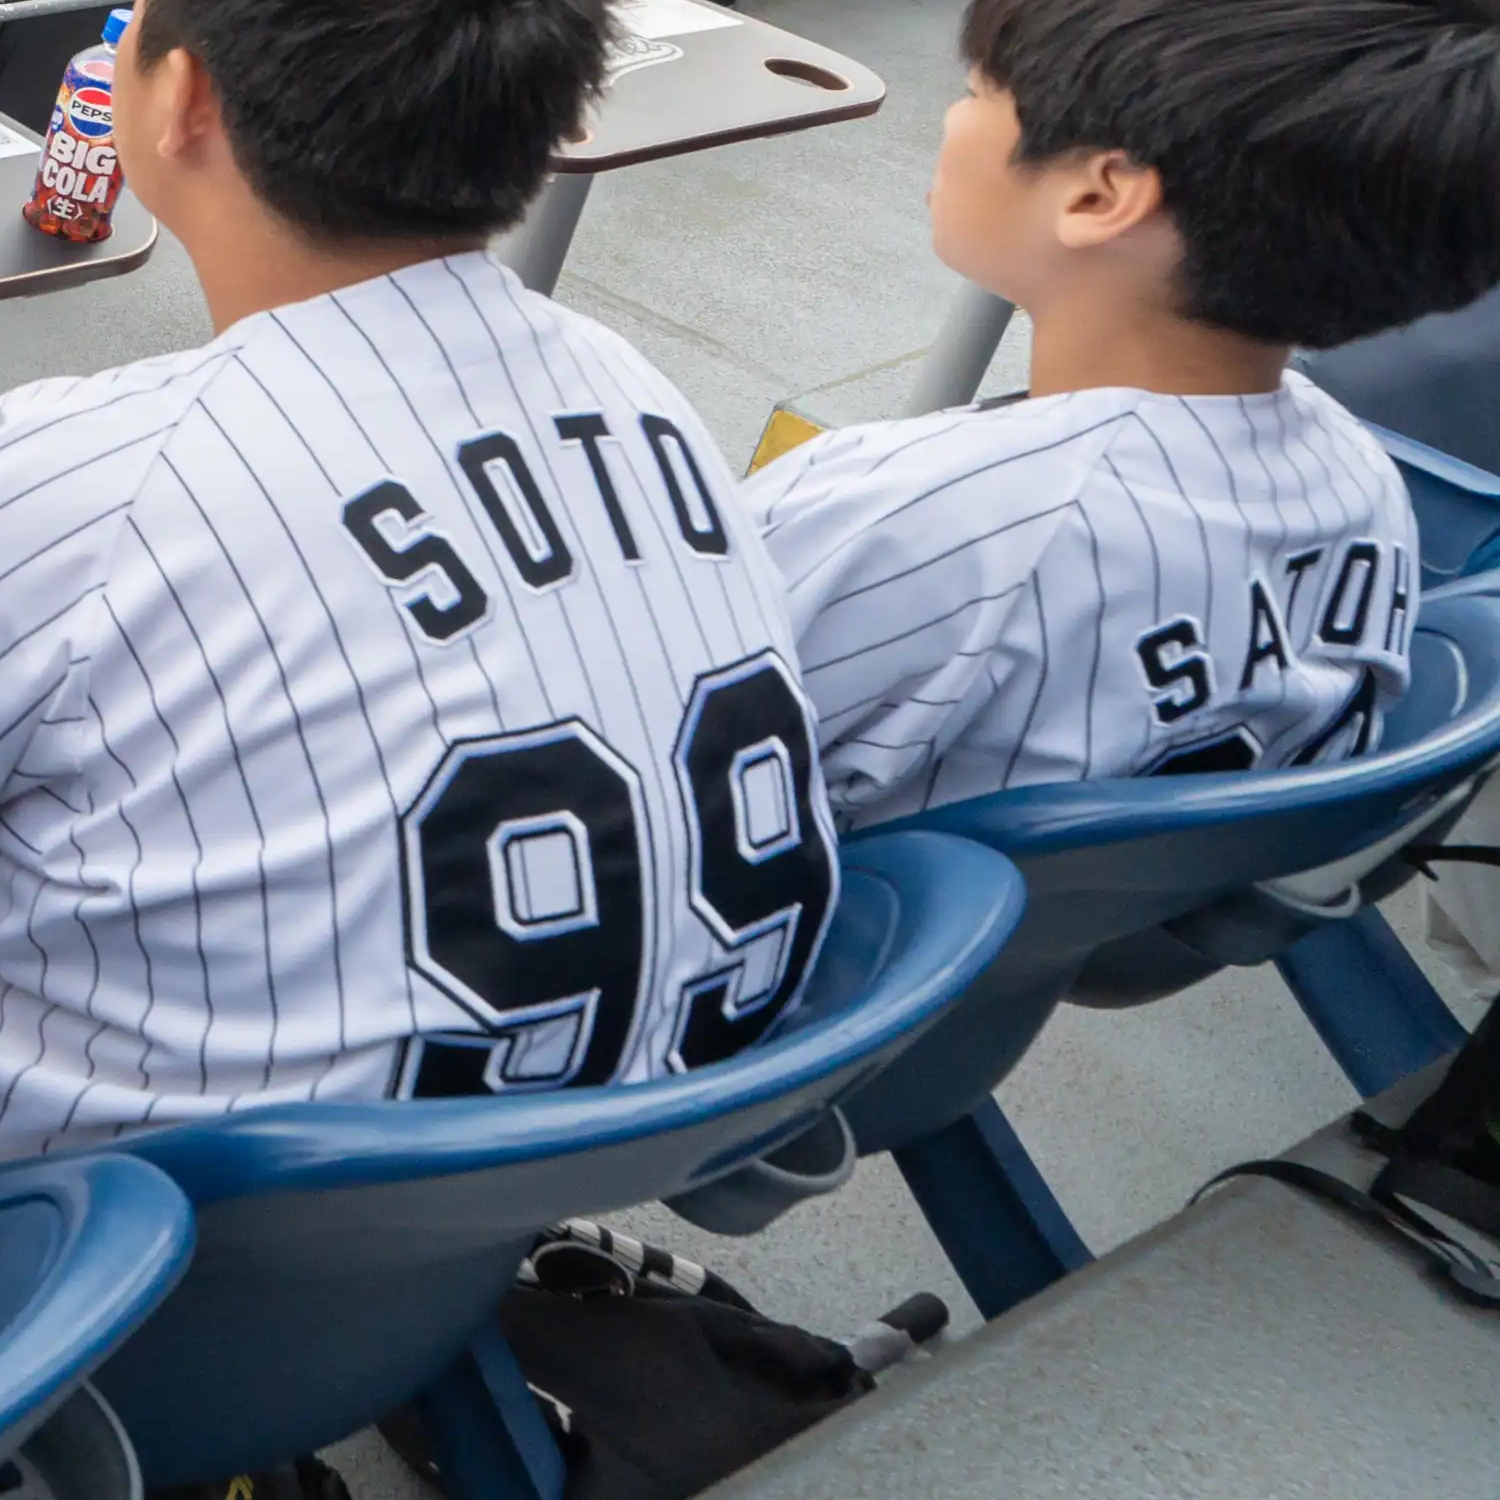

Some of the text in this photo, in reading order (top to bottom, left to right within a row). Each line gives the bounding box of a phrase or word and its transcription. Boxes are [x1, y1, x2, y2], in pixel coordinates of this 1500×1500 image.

[72, 99, 113, 123] PEPS
[49, 131, 117, 176] BIG
[42, 158, 110, 203] COLA
[340, 405, 732, 647] SOTO
[400, 647, 842, 1100] 99
